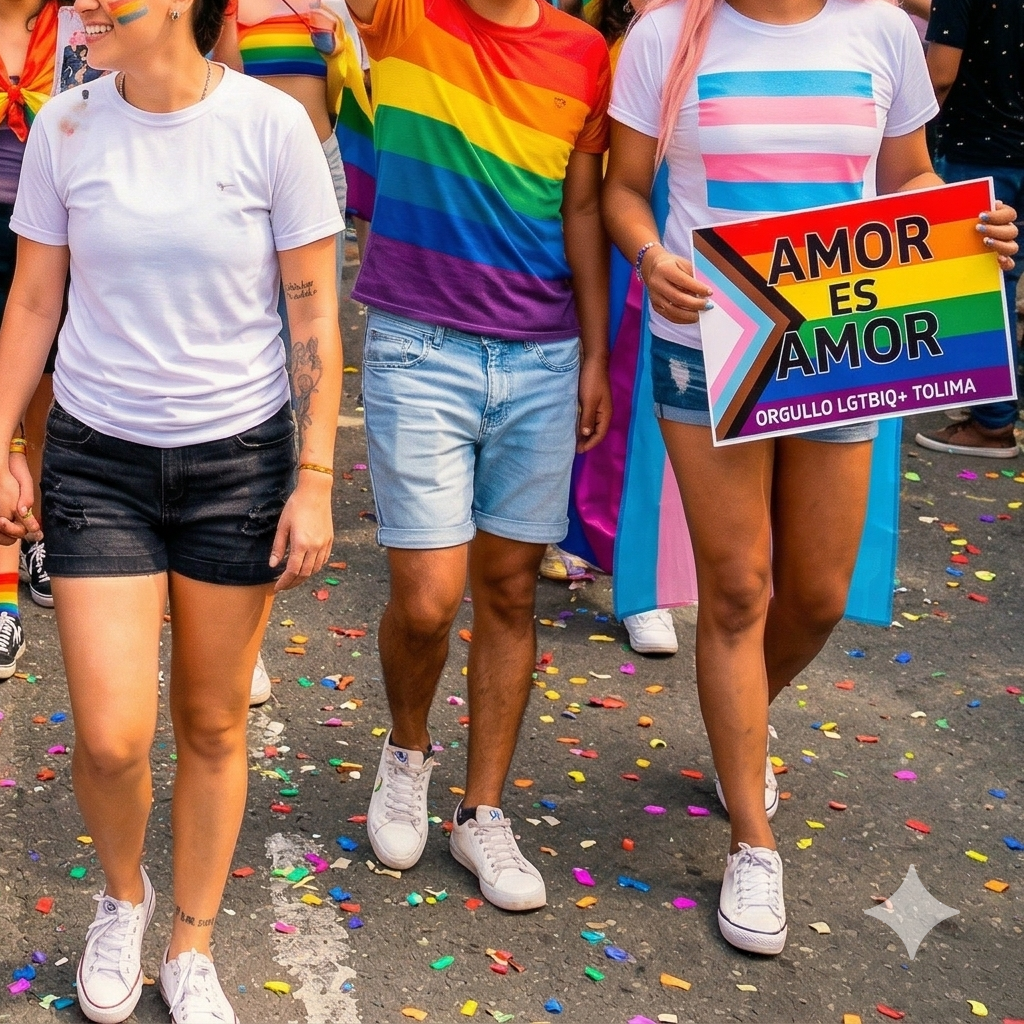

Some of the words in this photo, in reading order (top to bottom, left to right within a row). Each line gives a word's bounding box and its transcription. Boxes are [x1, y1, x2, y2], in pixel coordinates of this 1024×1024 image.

[766, 214, 934, 287] AMOR
[828, 278, 879, 317] ES
[775, 310, 944, 382] AMOR
[755, 399, 833, 427] ORGULLO
[837, 389, 908, 414] LGTBIQ+
[912, 377, 977, 401] TOLIMA
